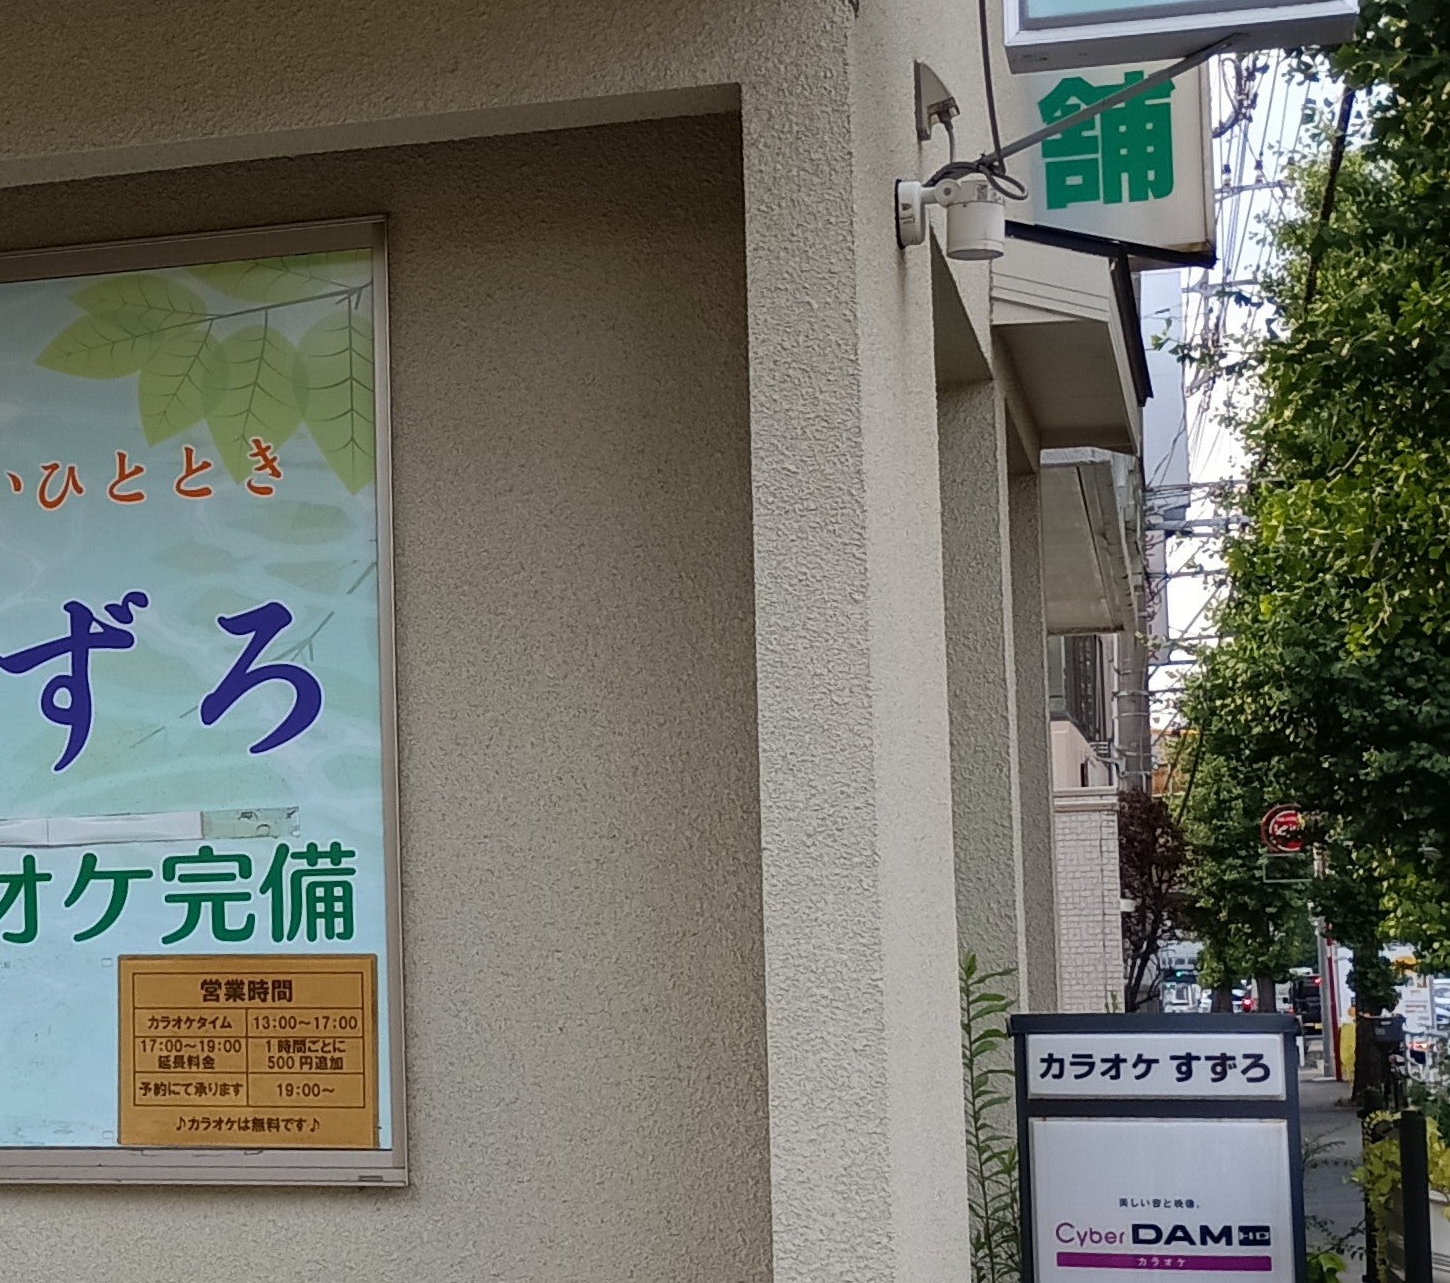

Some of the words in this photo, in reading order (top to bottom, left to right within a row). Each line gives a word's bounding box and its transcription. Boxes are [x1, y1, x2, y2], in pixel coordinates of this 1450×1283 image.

[1038, 69, 1176, 210] 舗
[200, 979, 293, 1003] 営業時間
[148, 1016, 232, 1030] カラオケタイム
[158, 1055, 215, 1070] 延長料金
[1039, 1053, 1160, 1081] カラオケ
[1169, 1052, 1271, 1083] すずろ
[139, 1082, 243, 1097] 予約にて承ります
[1055, 1222, 1125, 1248] Cyber
[1131, 1223, 1233, 1246] DAM
[1138, 1257, 1186, 1267] カラオケ
